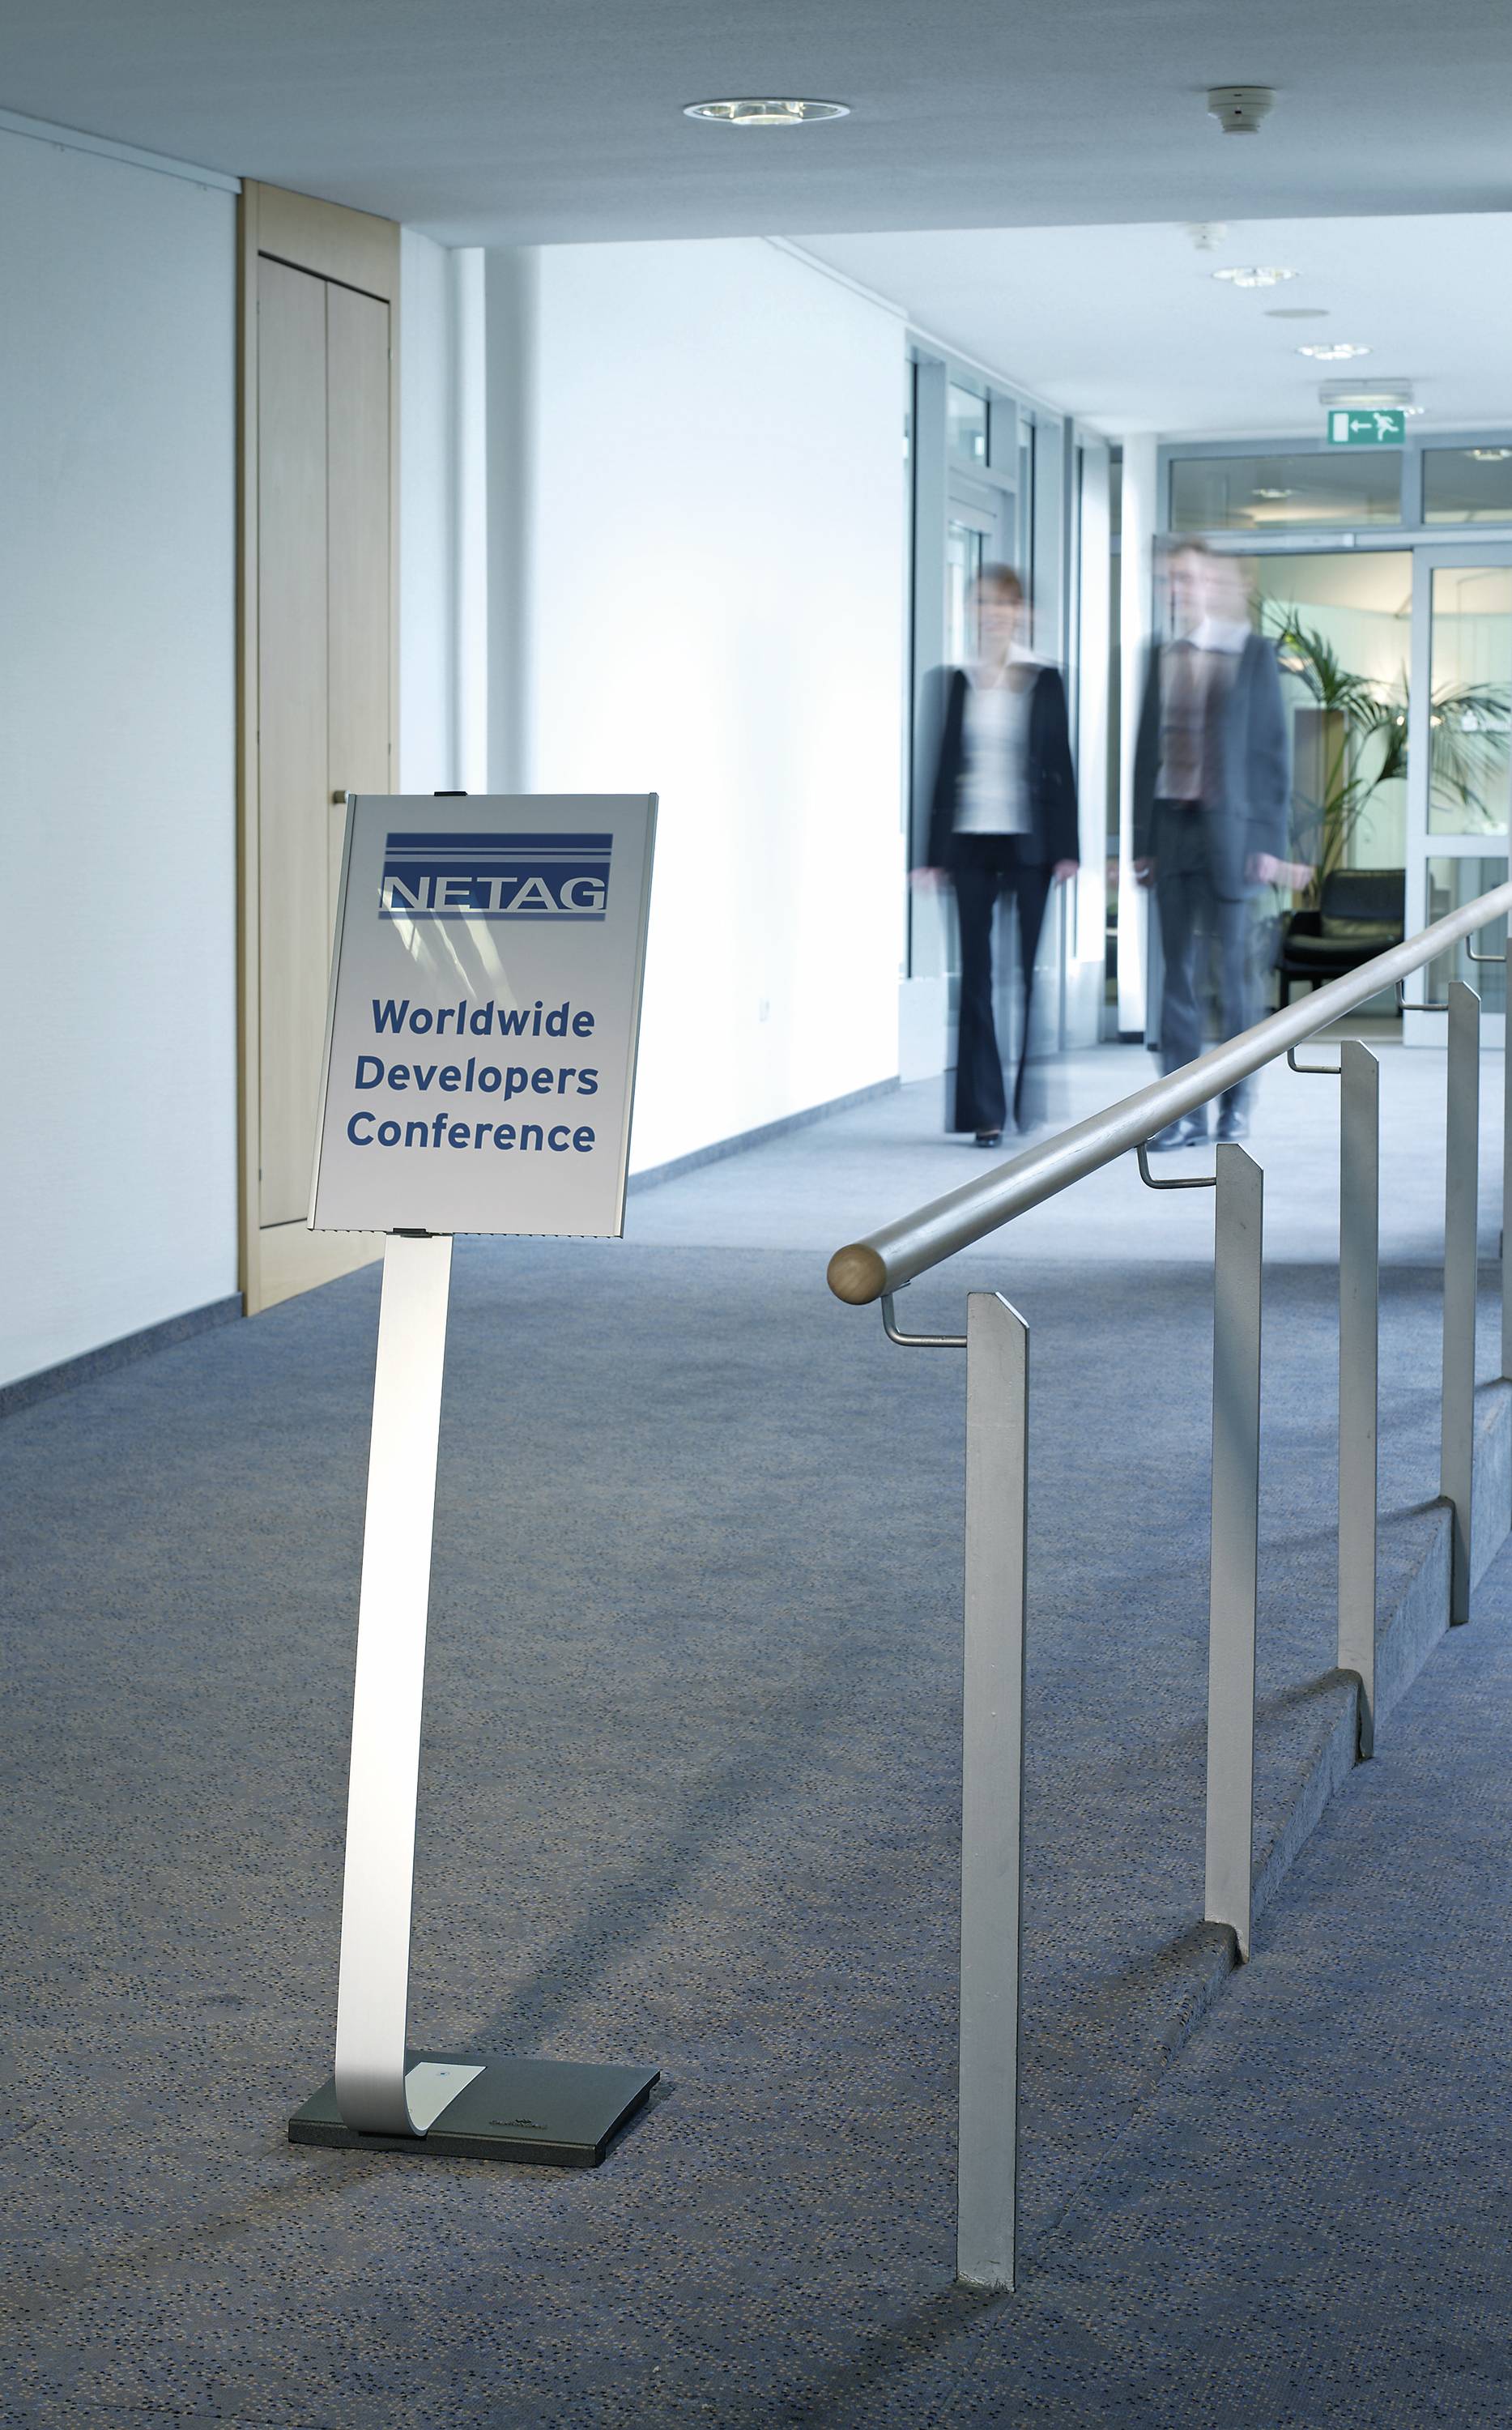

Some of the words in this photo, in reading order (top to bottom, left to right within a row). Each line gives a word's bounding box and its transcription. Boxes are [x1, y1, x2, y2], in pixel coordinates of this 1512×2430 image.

[381, 876, 606, 910] NETAG
[372, 998, 596, 1038] Worldwide
[354, 1055, 598, 1101] Developers
[347, 1111, 595, 1153] Conference
